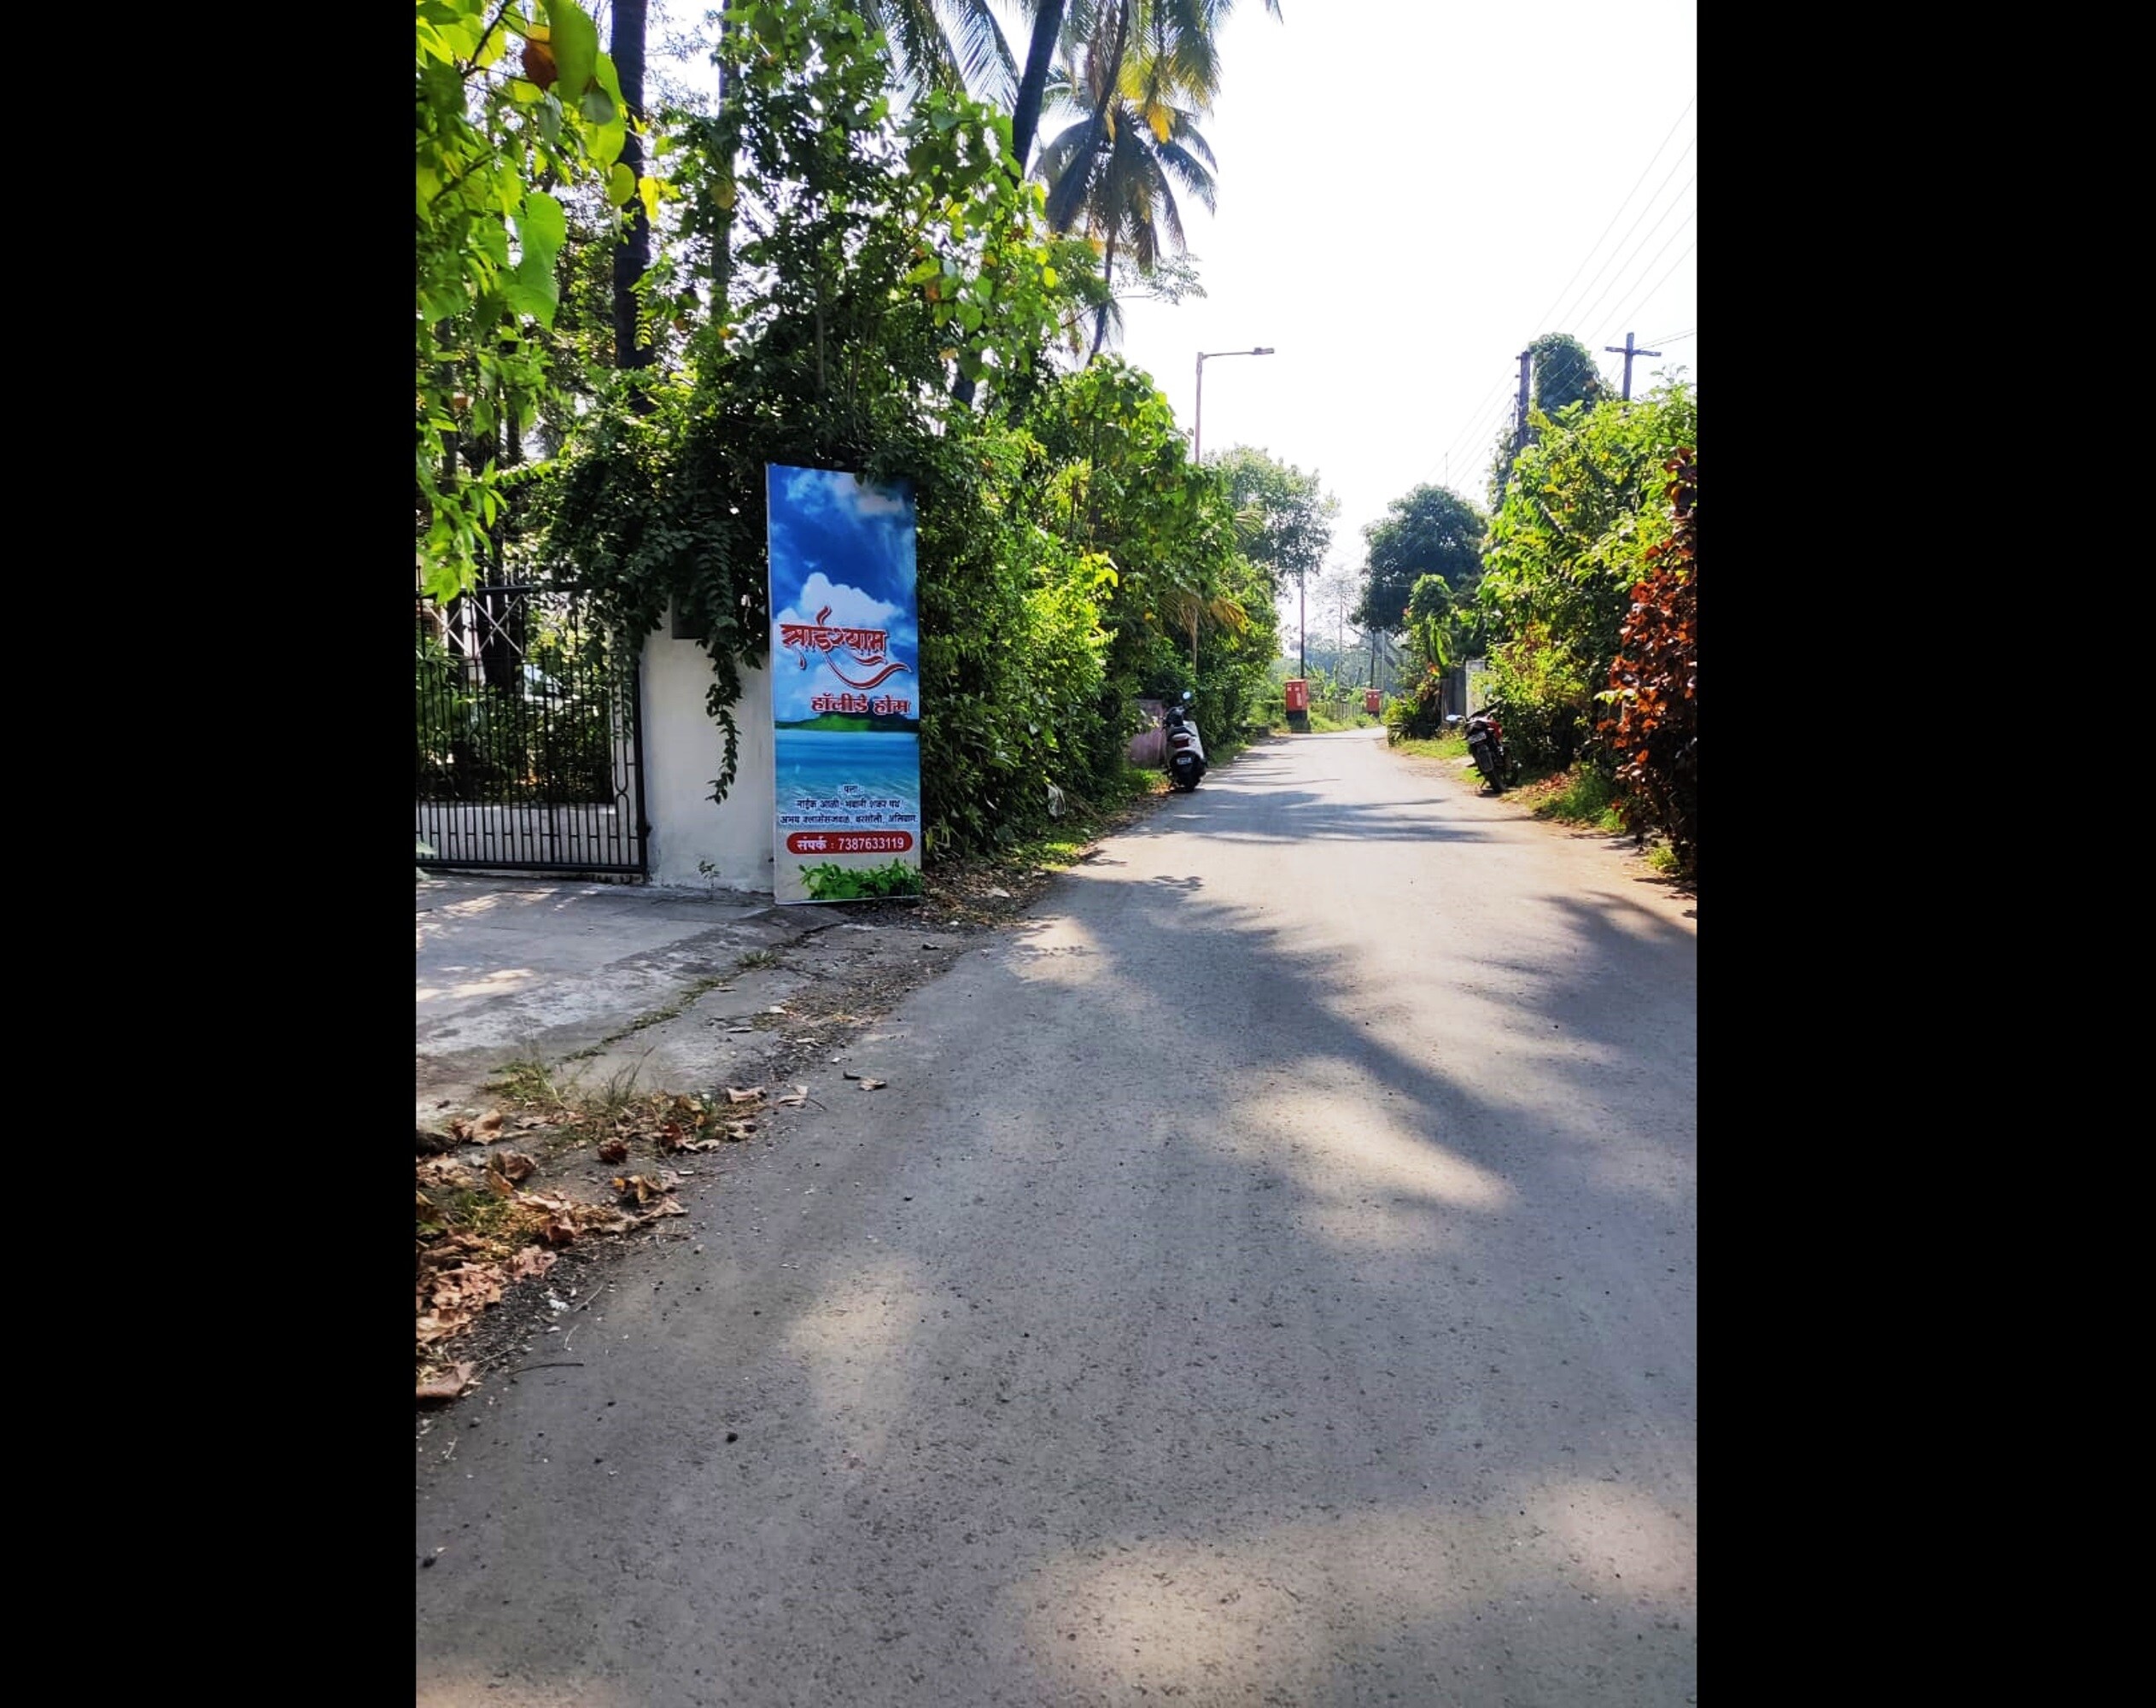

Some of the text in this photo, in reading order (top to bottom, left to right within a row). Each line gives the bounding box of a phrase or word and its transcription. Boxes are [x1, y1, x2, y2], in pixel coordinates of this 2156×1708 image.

[812, 693, 911, 714] हॉलीडे होम
[797, 836, 827, 851] संपर्क
[838, 837, 904, 851] 7387633119
